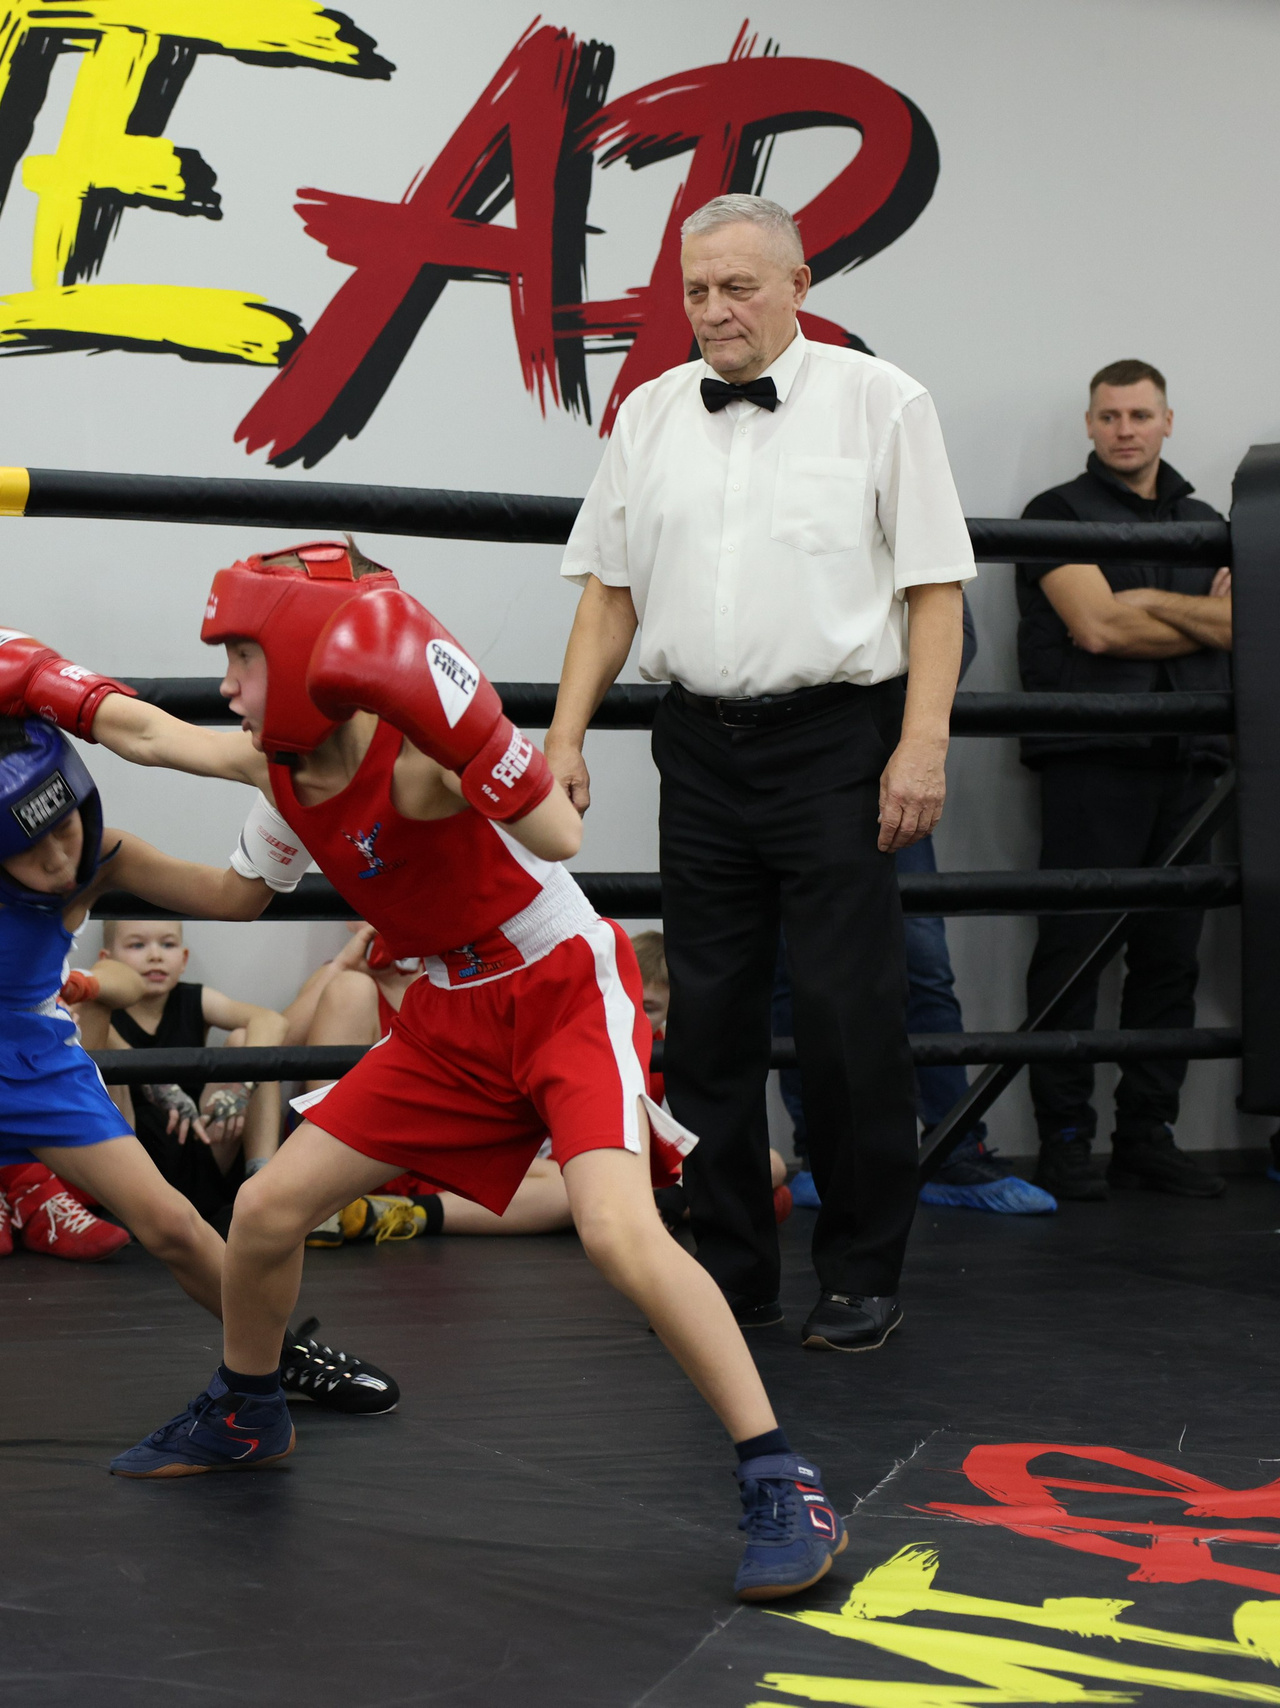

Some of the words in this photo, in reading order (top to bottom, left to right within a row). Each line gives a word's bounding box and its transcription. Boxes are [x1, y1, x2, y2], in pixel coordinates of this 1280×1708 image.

[432, 643, 477, 687] GREEN
[433, 655, 469, 695] HILL
[500, 742, 533, 788] HILL
